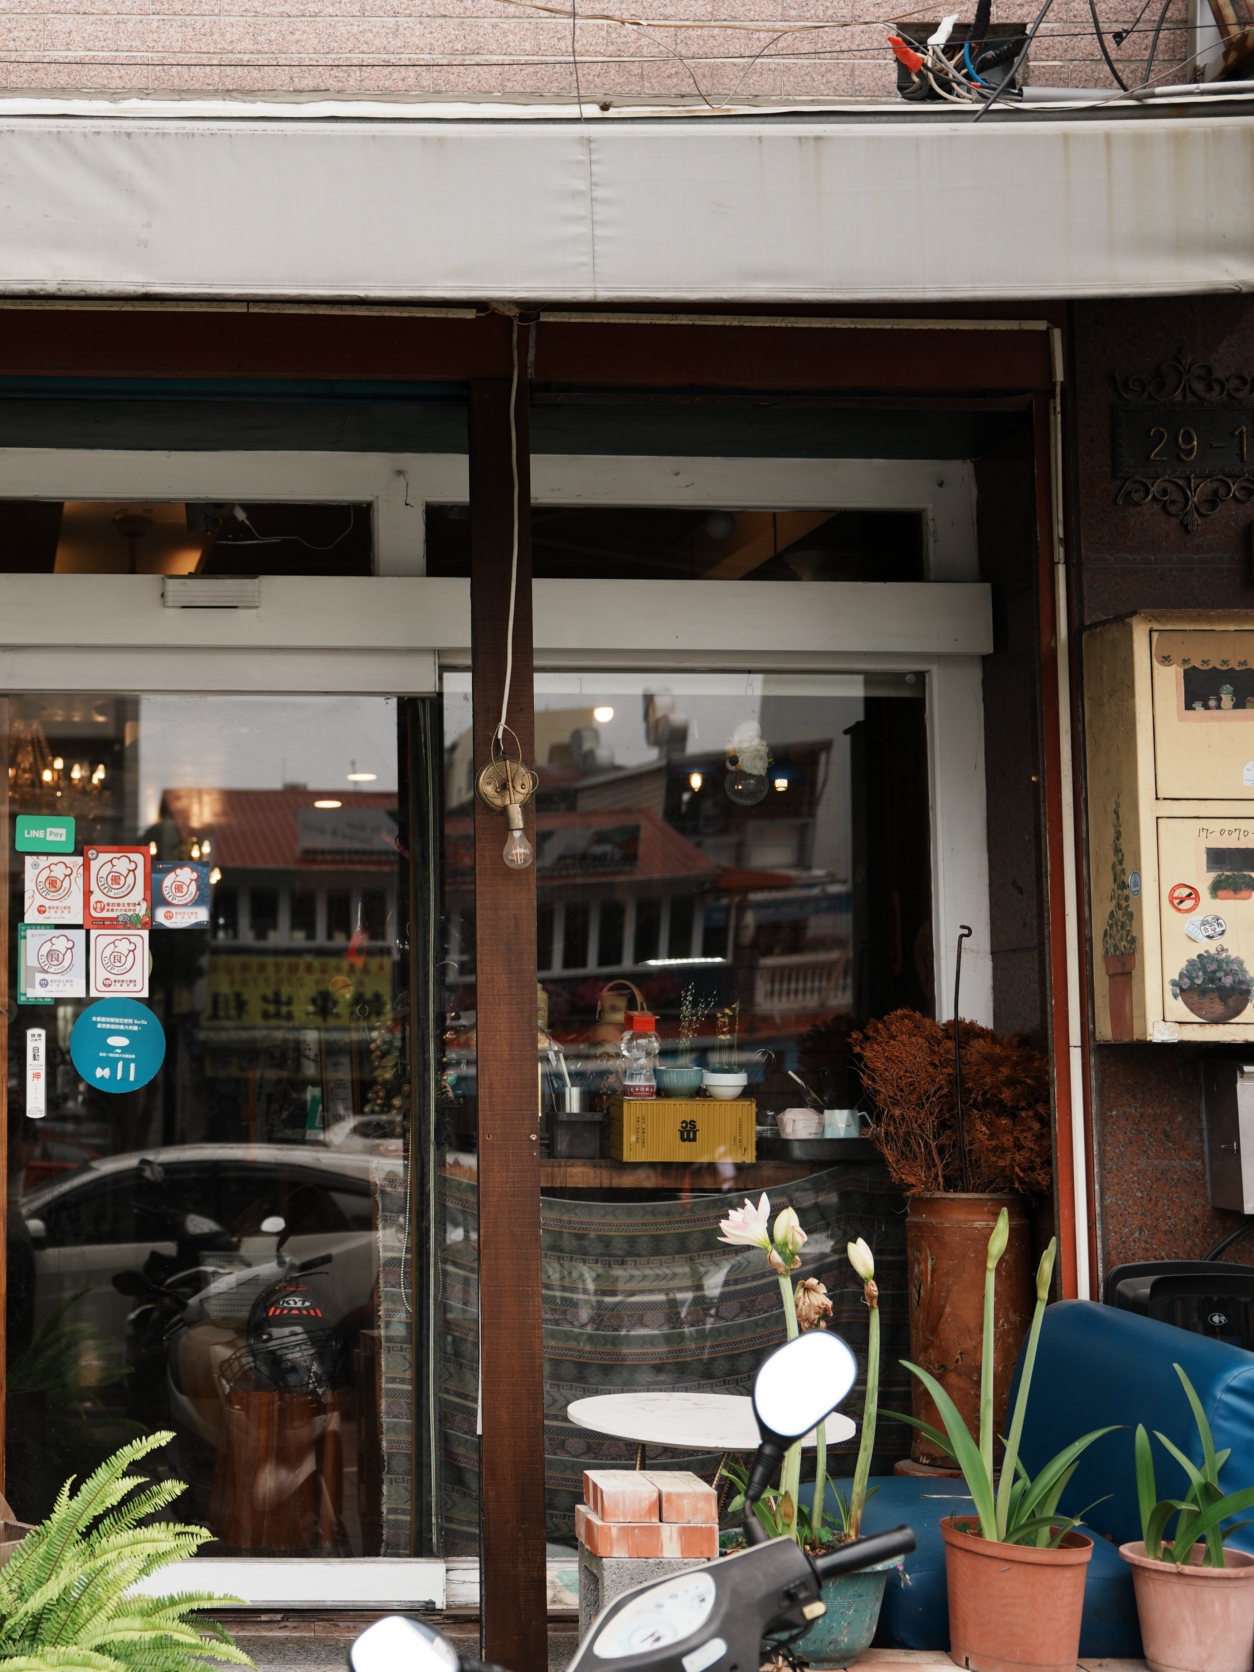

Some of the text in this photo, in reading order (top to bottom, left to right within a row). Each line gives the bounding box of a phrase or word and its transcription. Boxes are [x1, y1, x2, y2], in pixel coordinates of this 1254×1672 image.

[24, 829, 64, 840] LINE Pay
[32, 1046, 40, 1062] 自動
[32, 1071, 41, 1081] 押
